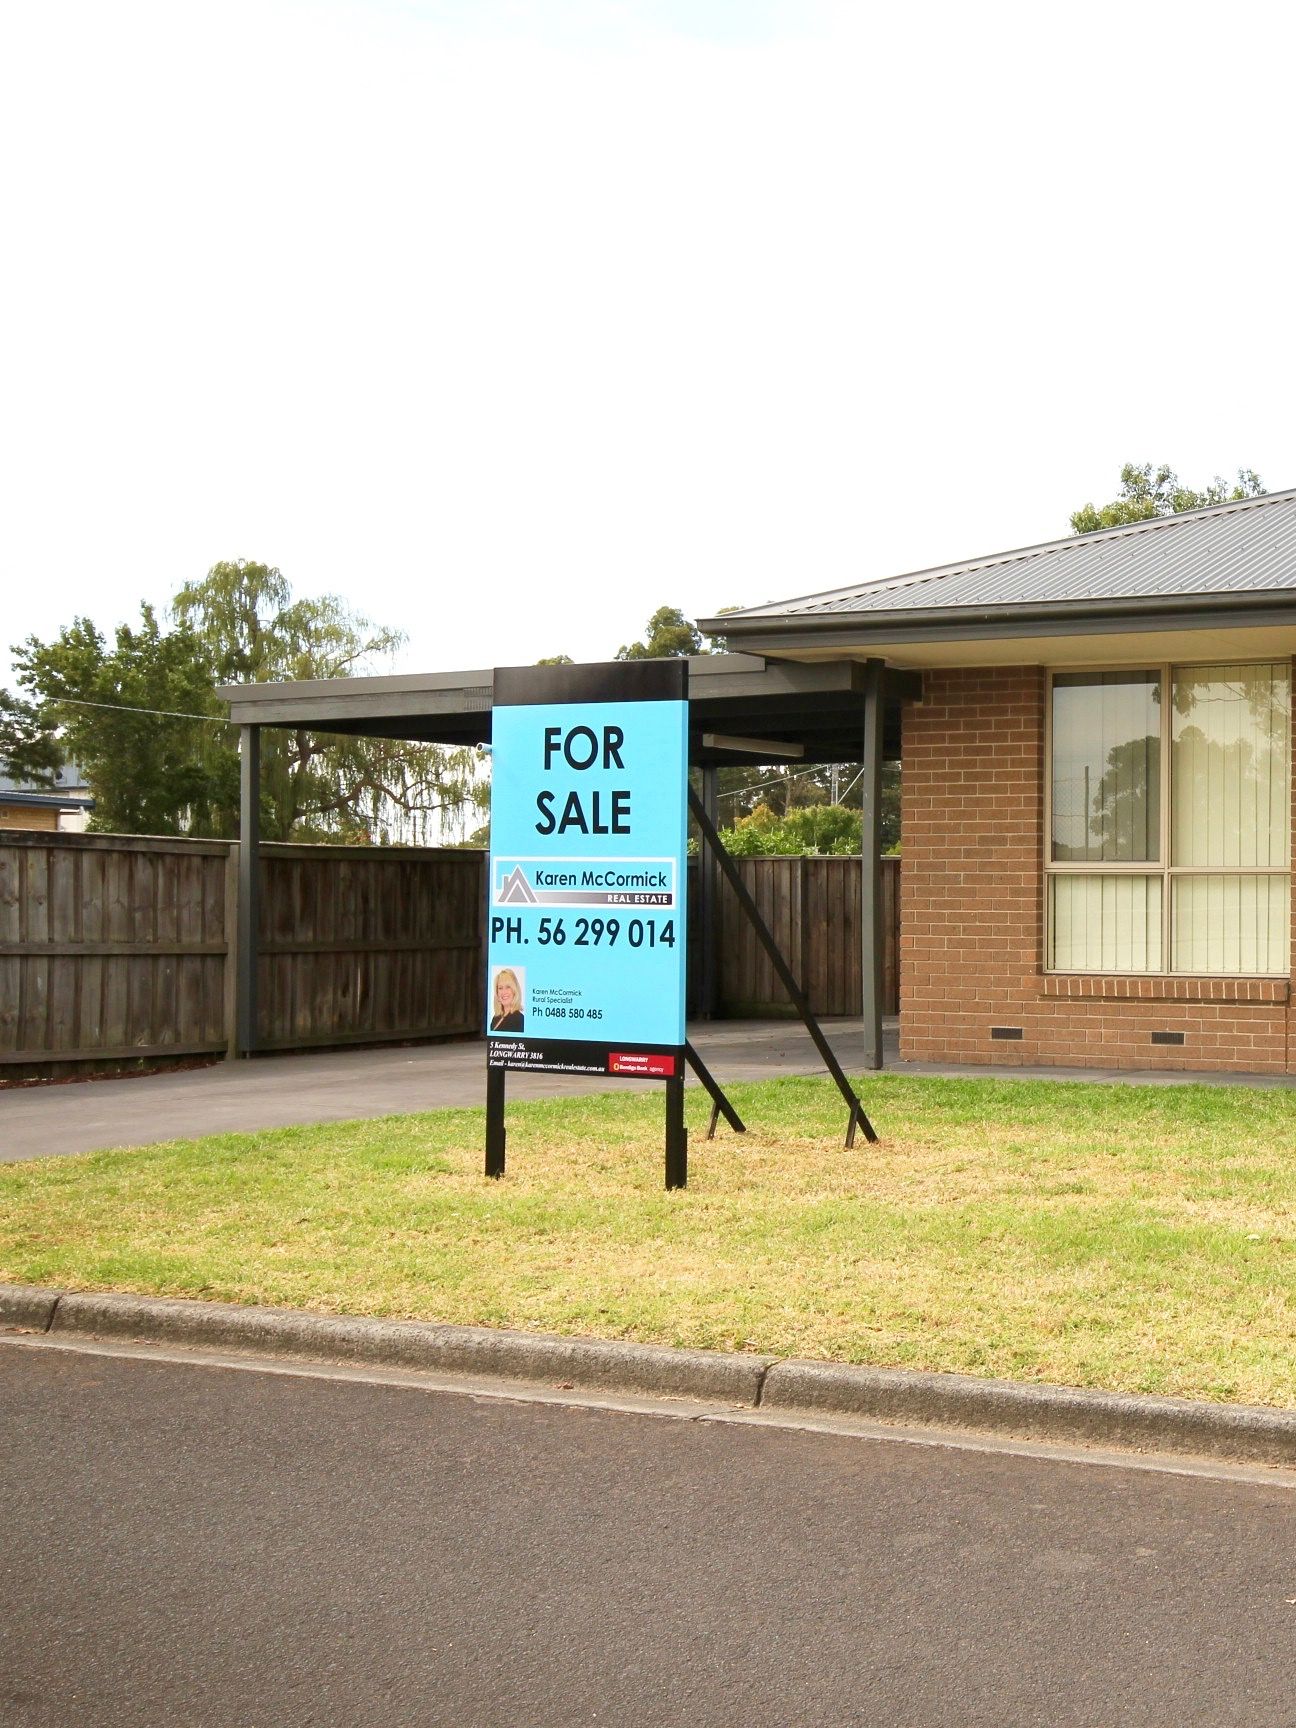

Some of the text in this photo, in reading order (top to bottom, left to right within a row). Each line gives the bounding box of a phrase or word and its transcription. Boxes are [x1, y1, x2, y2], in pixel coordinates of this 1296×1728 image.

[545, 725, 625, 770] FOR
[535, 790, 631, 835] SALE
[535, 870, 667, 887] Karen McCormick
[607, 894, 668, 904] REAL ESTATE
[491, 917, 675, 948] PH. 56 299 014
[532, 1007, 603, 1019] Ph 0488 580 485
[494, 1042, 517, 1050] Kennedy
[489, 1050, 543, 1060] LONGWARRY 3816
[489, 1059, 504, 1067] Email
